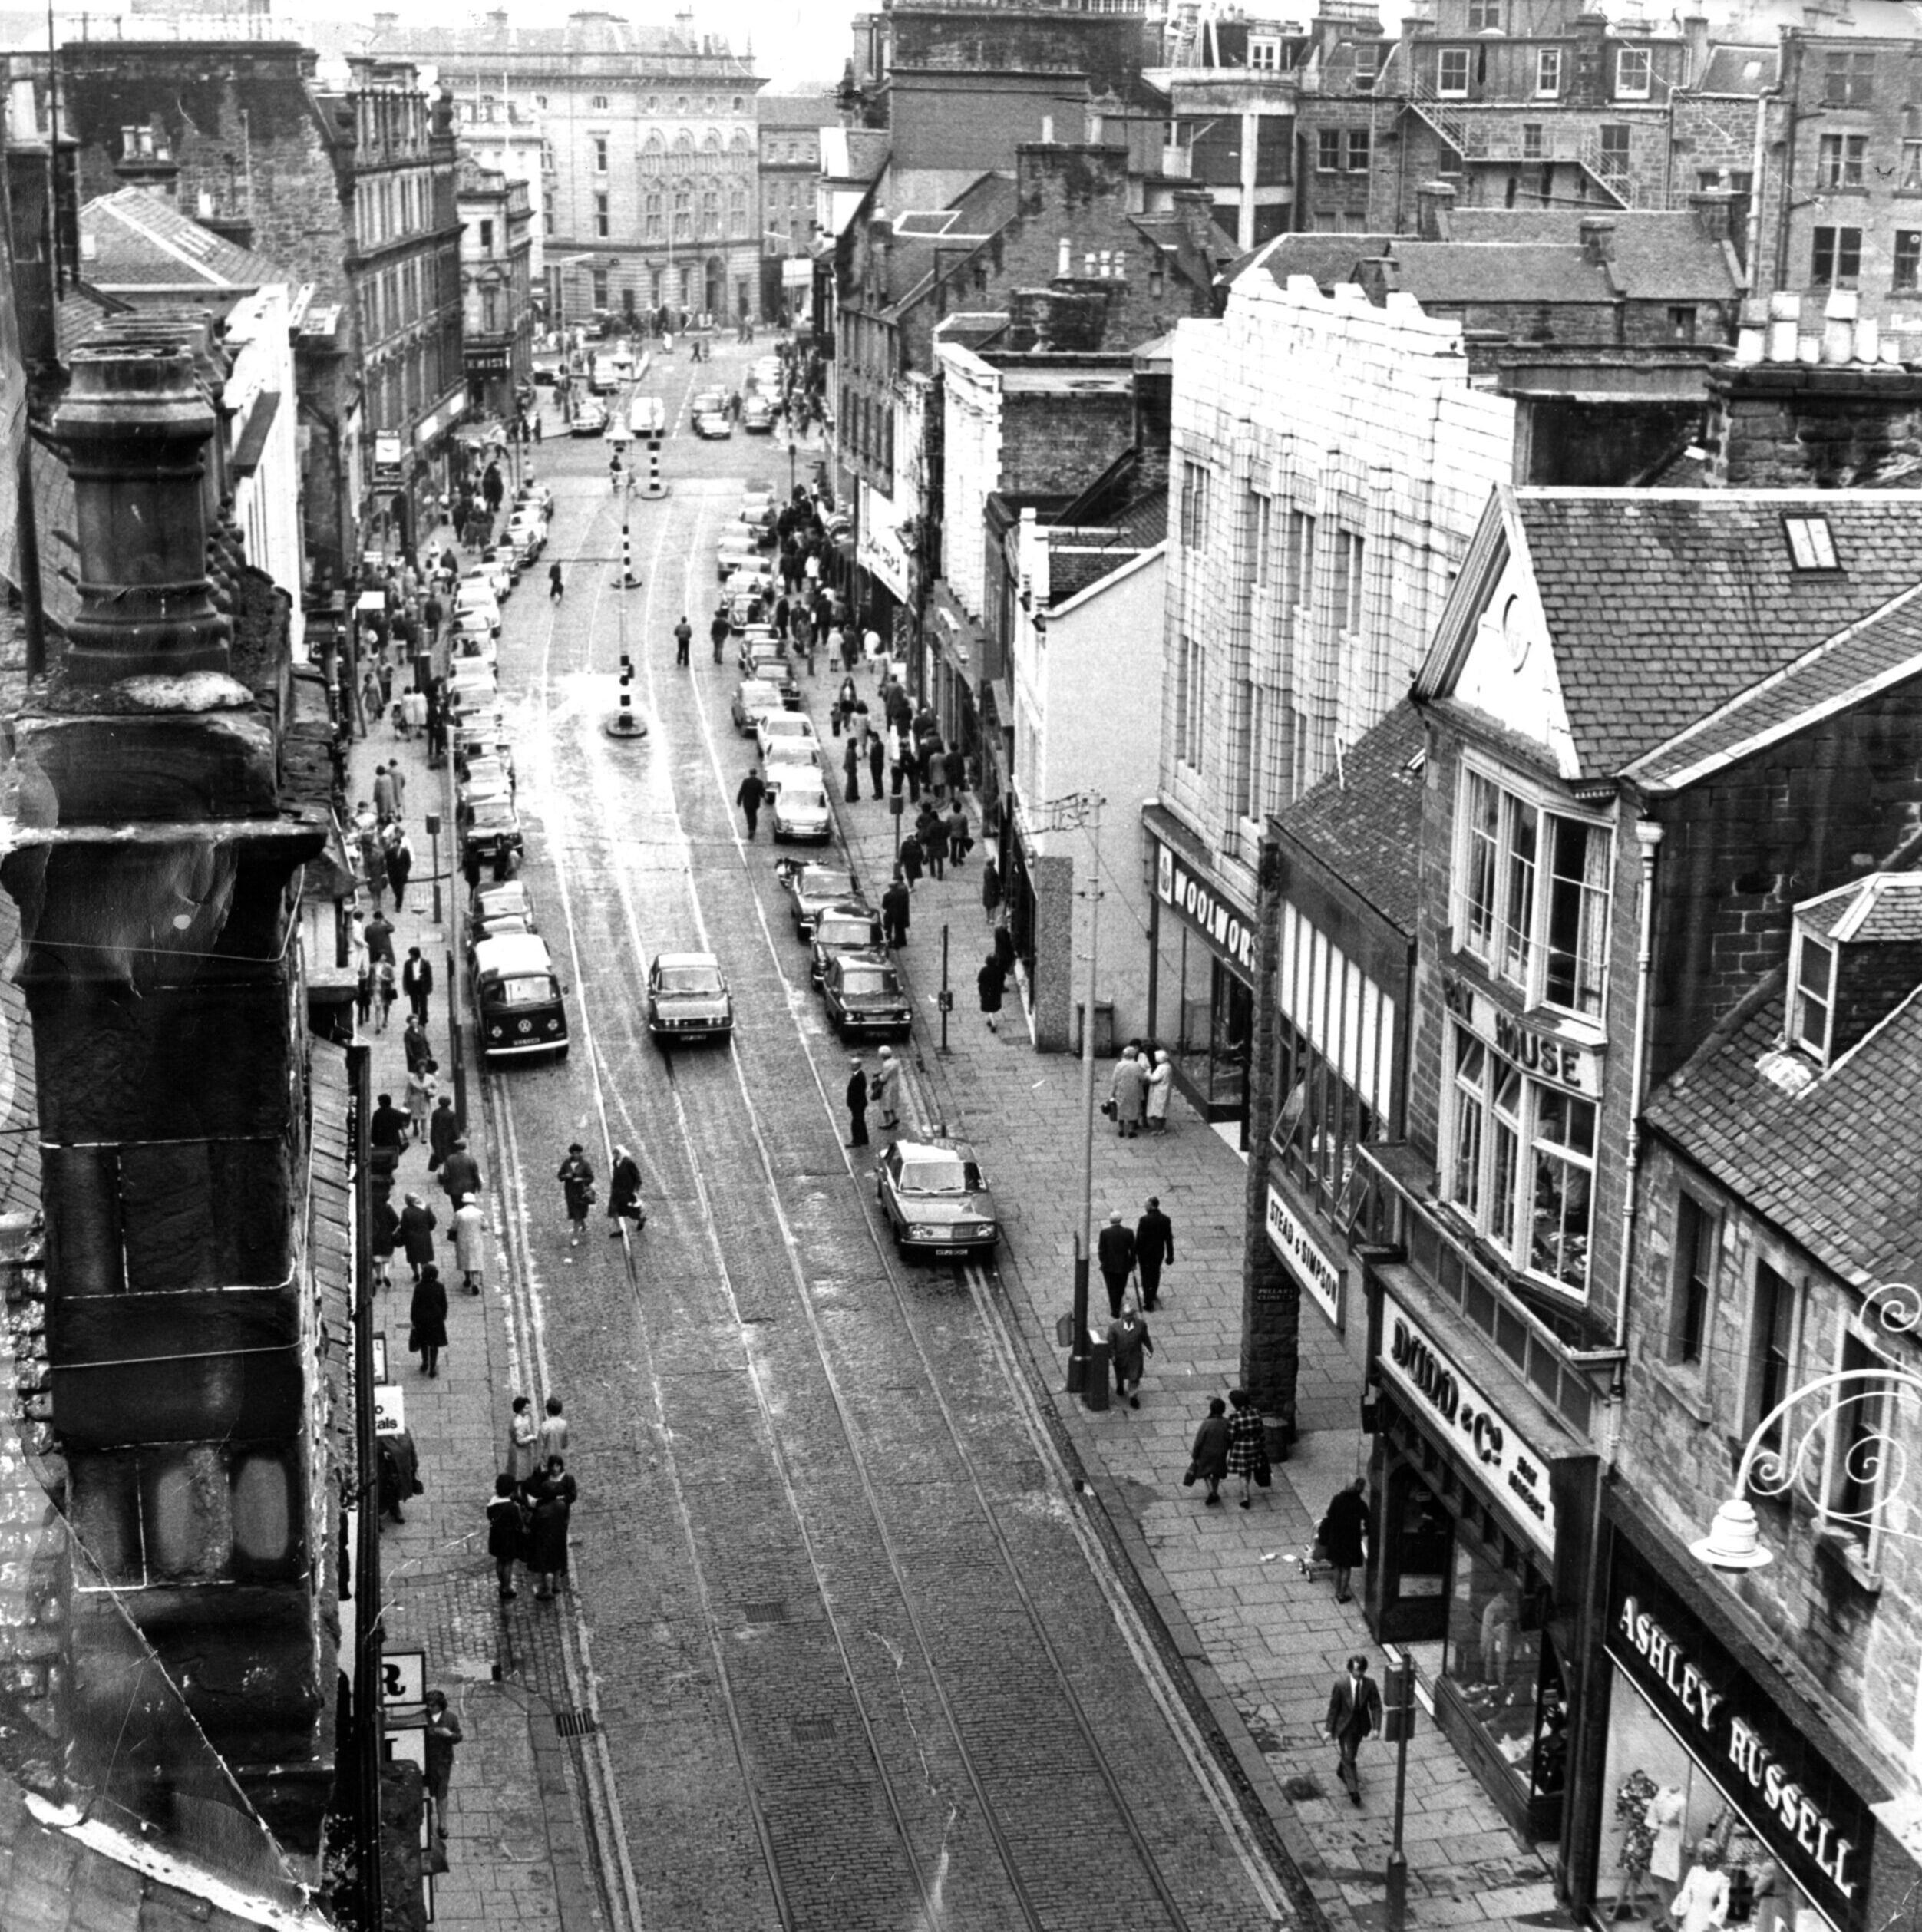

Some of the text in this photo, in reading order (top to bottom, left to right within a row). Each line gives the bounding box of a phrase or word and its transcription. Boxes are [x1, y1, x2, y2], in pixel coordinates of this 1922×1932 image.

[1495, 1011, 1581, 1088] HOUSE
[1270, 1198, 1338, 1305] STEAD & SIMPSON
[376, 1417, 398, 1430] als
[1619, 1596, 1856, 1898] ASHLEY RUSSELL
